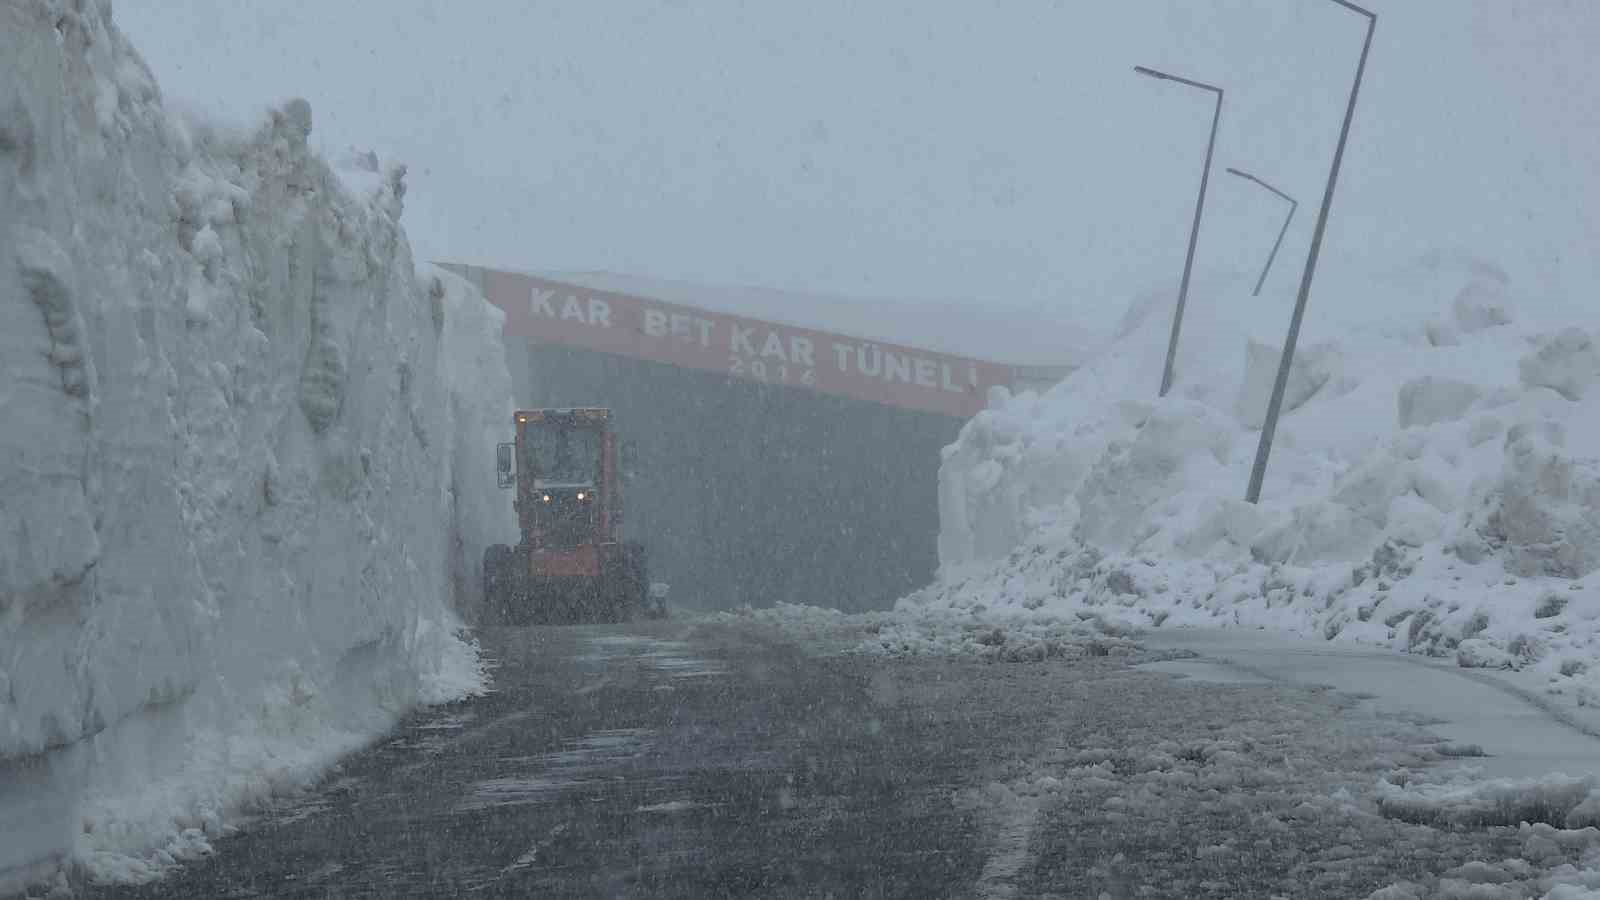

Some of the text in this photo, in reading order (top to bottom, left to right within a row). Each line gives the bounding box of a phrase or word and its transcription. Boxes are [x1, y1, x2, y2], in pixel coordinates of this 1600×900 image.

[530, 287, 612, 328] KAR
[643, 308, 716, 346] BET
[729, 321, 815, 367] KAR
